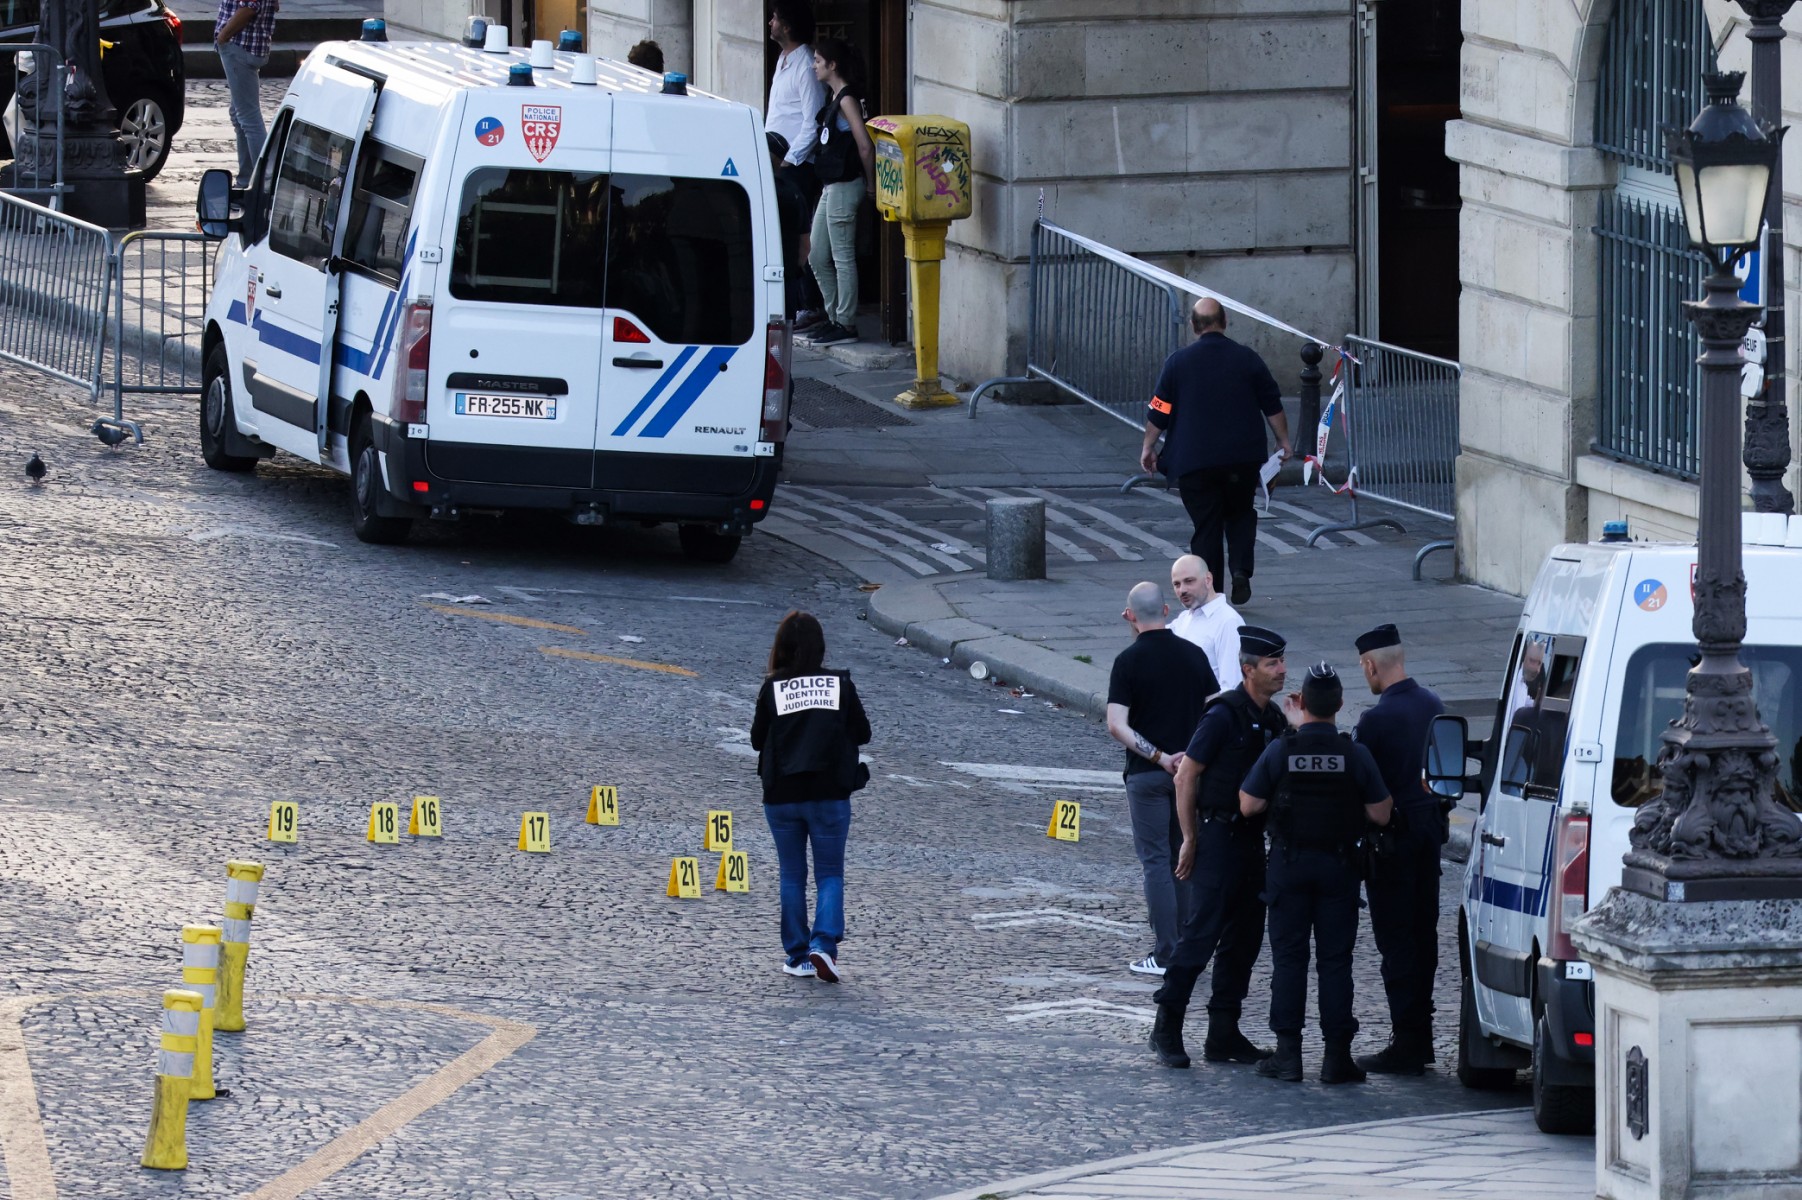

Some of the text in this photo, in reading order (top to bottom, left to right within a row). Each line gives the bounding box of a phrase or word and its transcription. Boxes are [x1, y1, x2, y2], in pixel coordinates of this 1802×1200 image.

[527, 107, 556, 115] POLICE
[524, 122, 558, 137] CRS
[488, 134, 500, 143] 21
[725, 163, 731, 174] 1
[478, 380, 539, 390] MASTER
[468, 397, 543, 416] FR-255-NK
[694, 426, 746, 435] RENAULT
[1648, 598, 1660, 607] 21
[780, 678, 835, 692] POLICE
[786, 690, 830, 701] IDENTITE
[783, 699, 834, 711] JUDICIAIRE
[1295, 757, 1338, 770] CRS
[600, 789, 614, 813] 14
[276, 805, 293, 832] 19
[378, 807, 394, 833] 18
[421, 801, 437, 827] 16
[1061, 804, 1076, 829] 22
[529, 816, 544, 842] 17
[711, 815, 730, 843] 15
[680, 860, 695, 886] 21
[728, 855, 744, 881] 20
